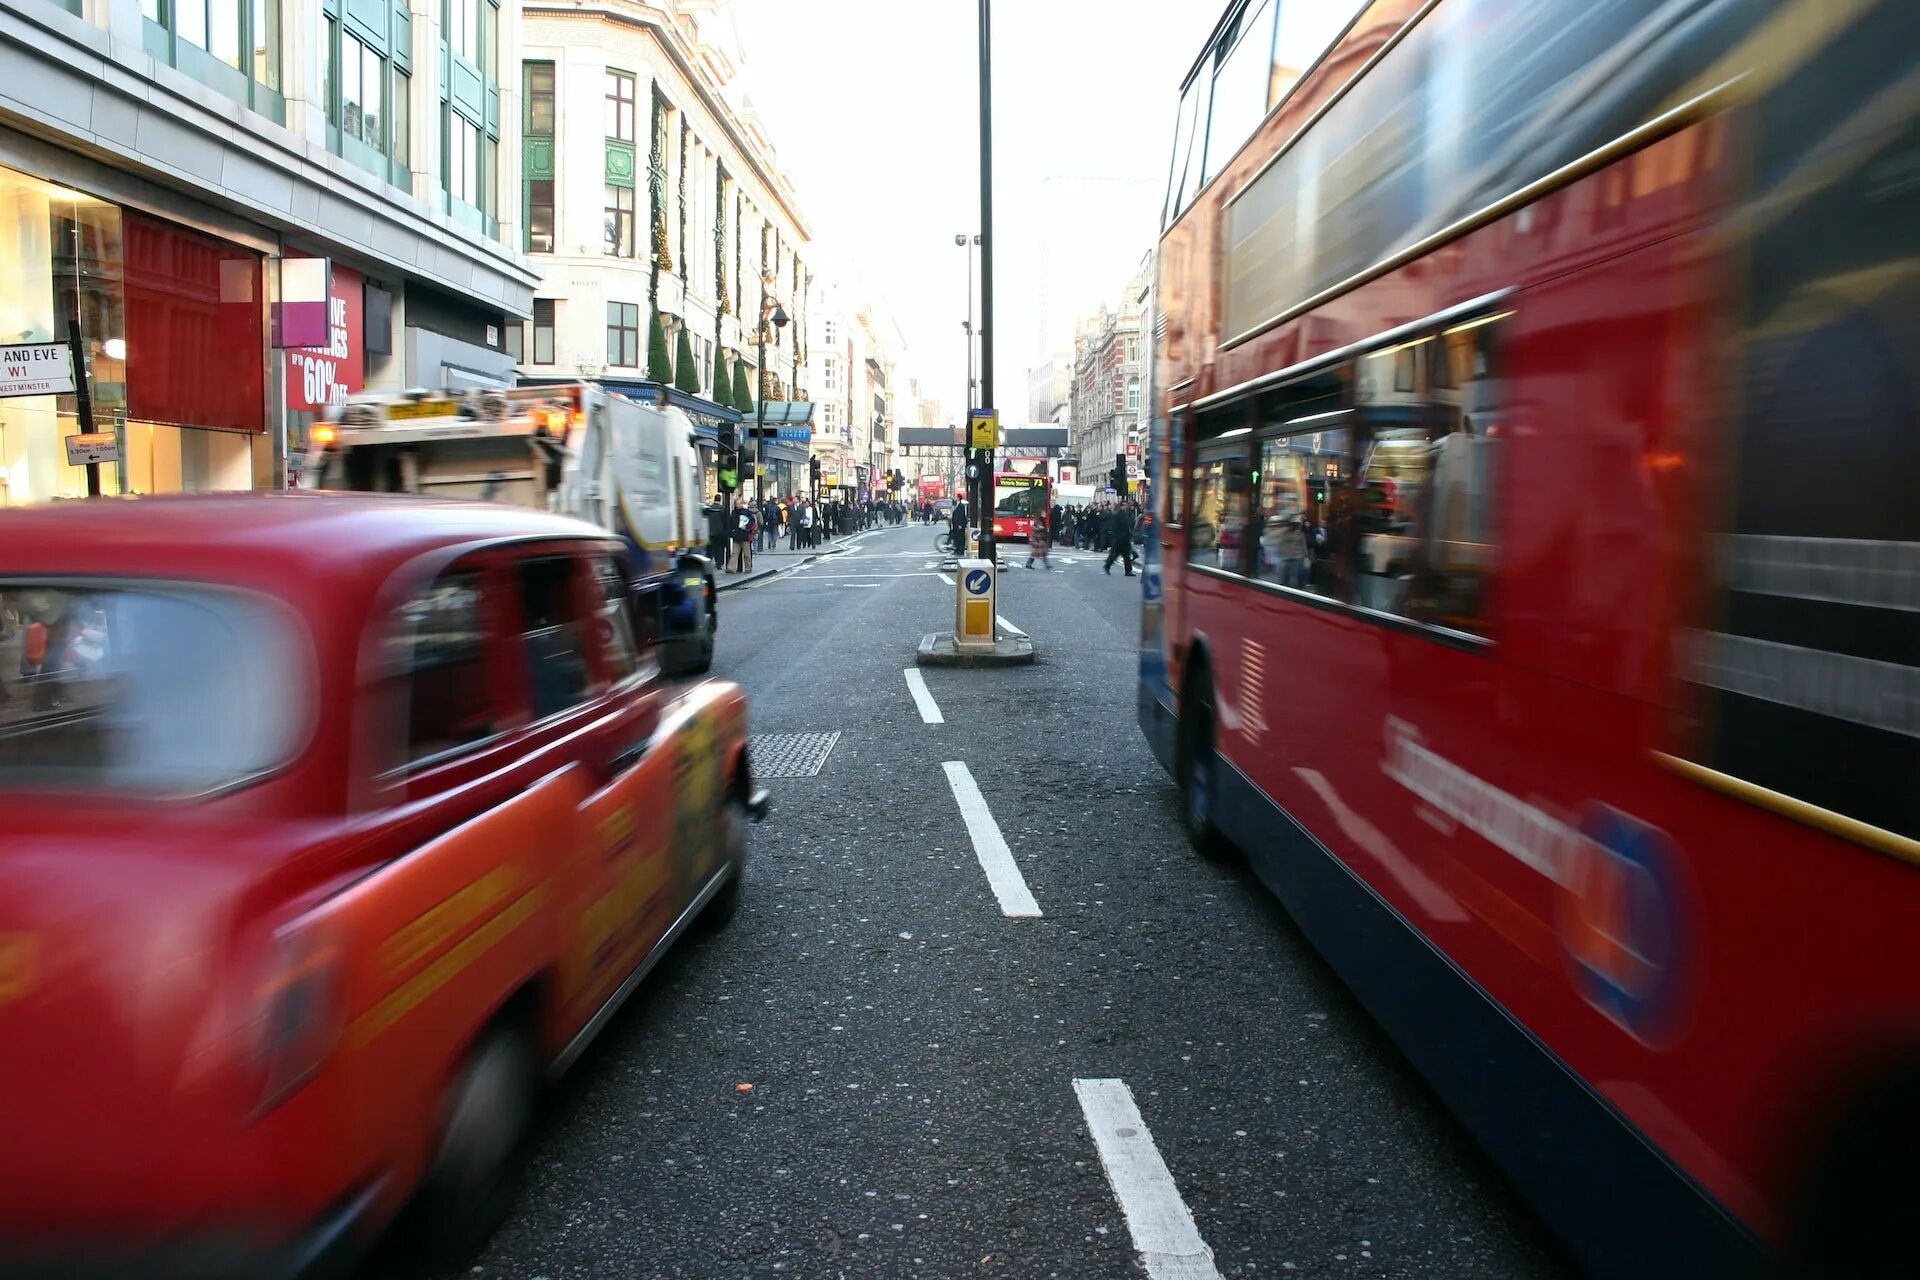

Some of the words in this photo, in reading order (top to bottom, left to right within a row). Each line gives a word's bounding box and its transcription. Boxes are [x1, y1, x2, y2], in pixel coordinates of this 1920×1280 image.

[4, 350, 30, 363] AND
[33, 348, 59, 361] EVE
[7, 365, 27, 377] W1
[304, 356, 337, 404] 60%
[1033, 479, 1043, 487] 73
